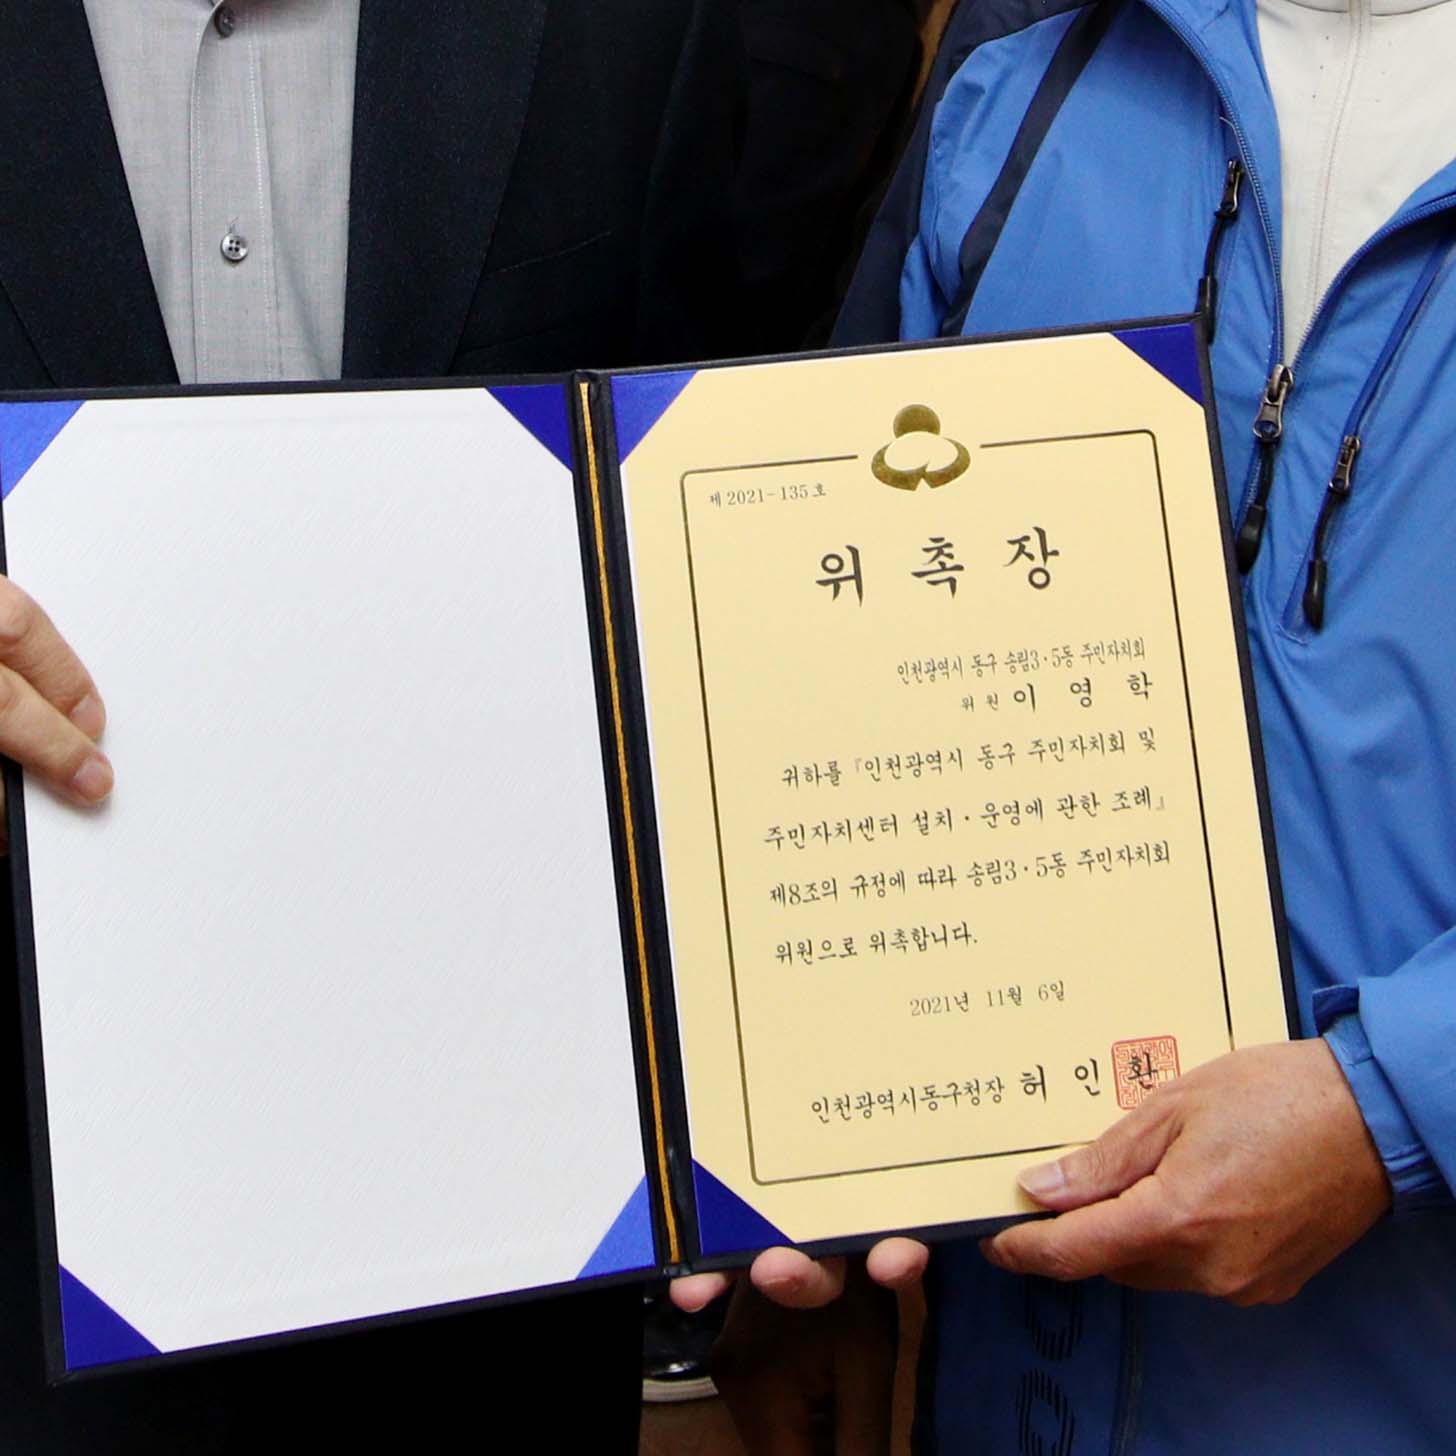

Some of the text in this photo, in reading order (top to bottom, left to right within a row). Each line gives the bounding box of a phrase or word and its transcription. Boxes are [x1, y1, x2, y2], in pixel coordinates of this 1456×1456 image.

[727, 483, 809, 507] 2021-135
[896, 654, 964, 686] 인천광역시
[970, 652, 998, 678] 동구
[1079, 636, 1146, 666] 주민자치회
[781, 759, 843, 790] 귀하를
[977, 742, 1016, 772] 동구
[1028, 730, 1126, 764] 주민자치회
[1138, 726, 1157, 753] 및
[763, 813, 899, 852] 주민자치센터
[1056, 791, 1101, 821] 관한
[769, 876, 839, 909] 제8조의
[849, 869, 907, 900] 규정에
[918, 863, 958, 891] 따라
[1076, 840, 1171, 875] 주민자치회
[775, 919, 978, 968] 위원으로 위촉합니다.
[909, 980, 1066, 1017] 2021년 11월 6일
[810, 1076, 1006, 1125] 인천광역시동구청장
